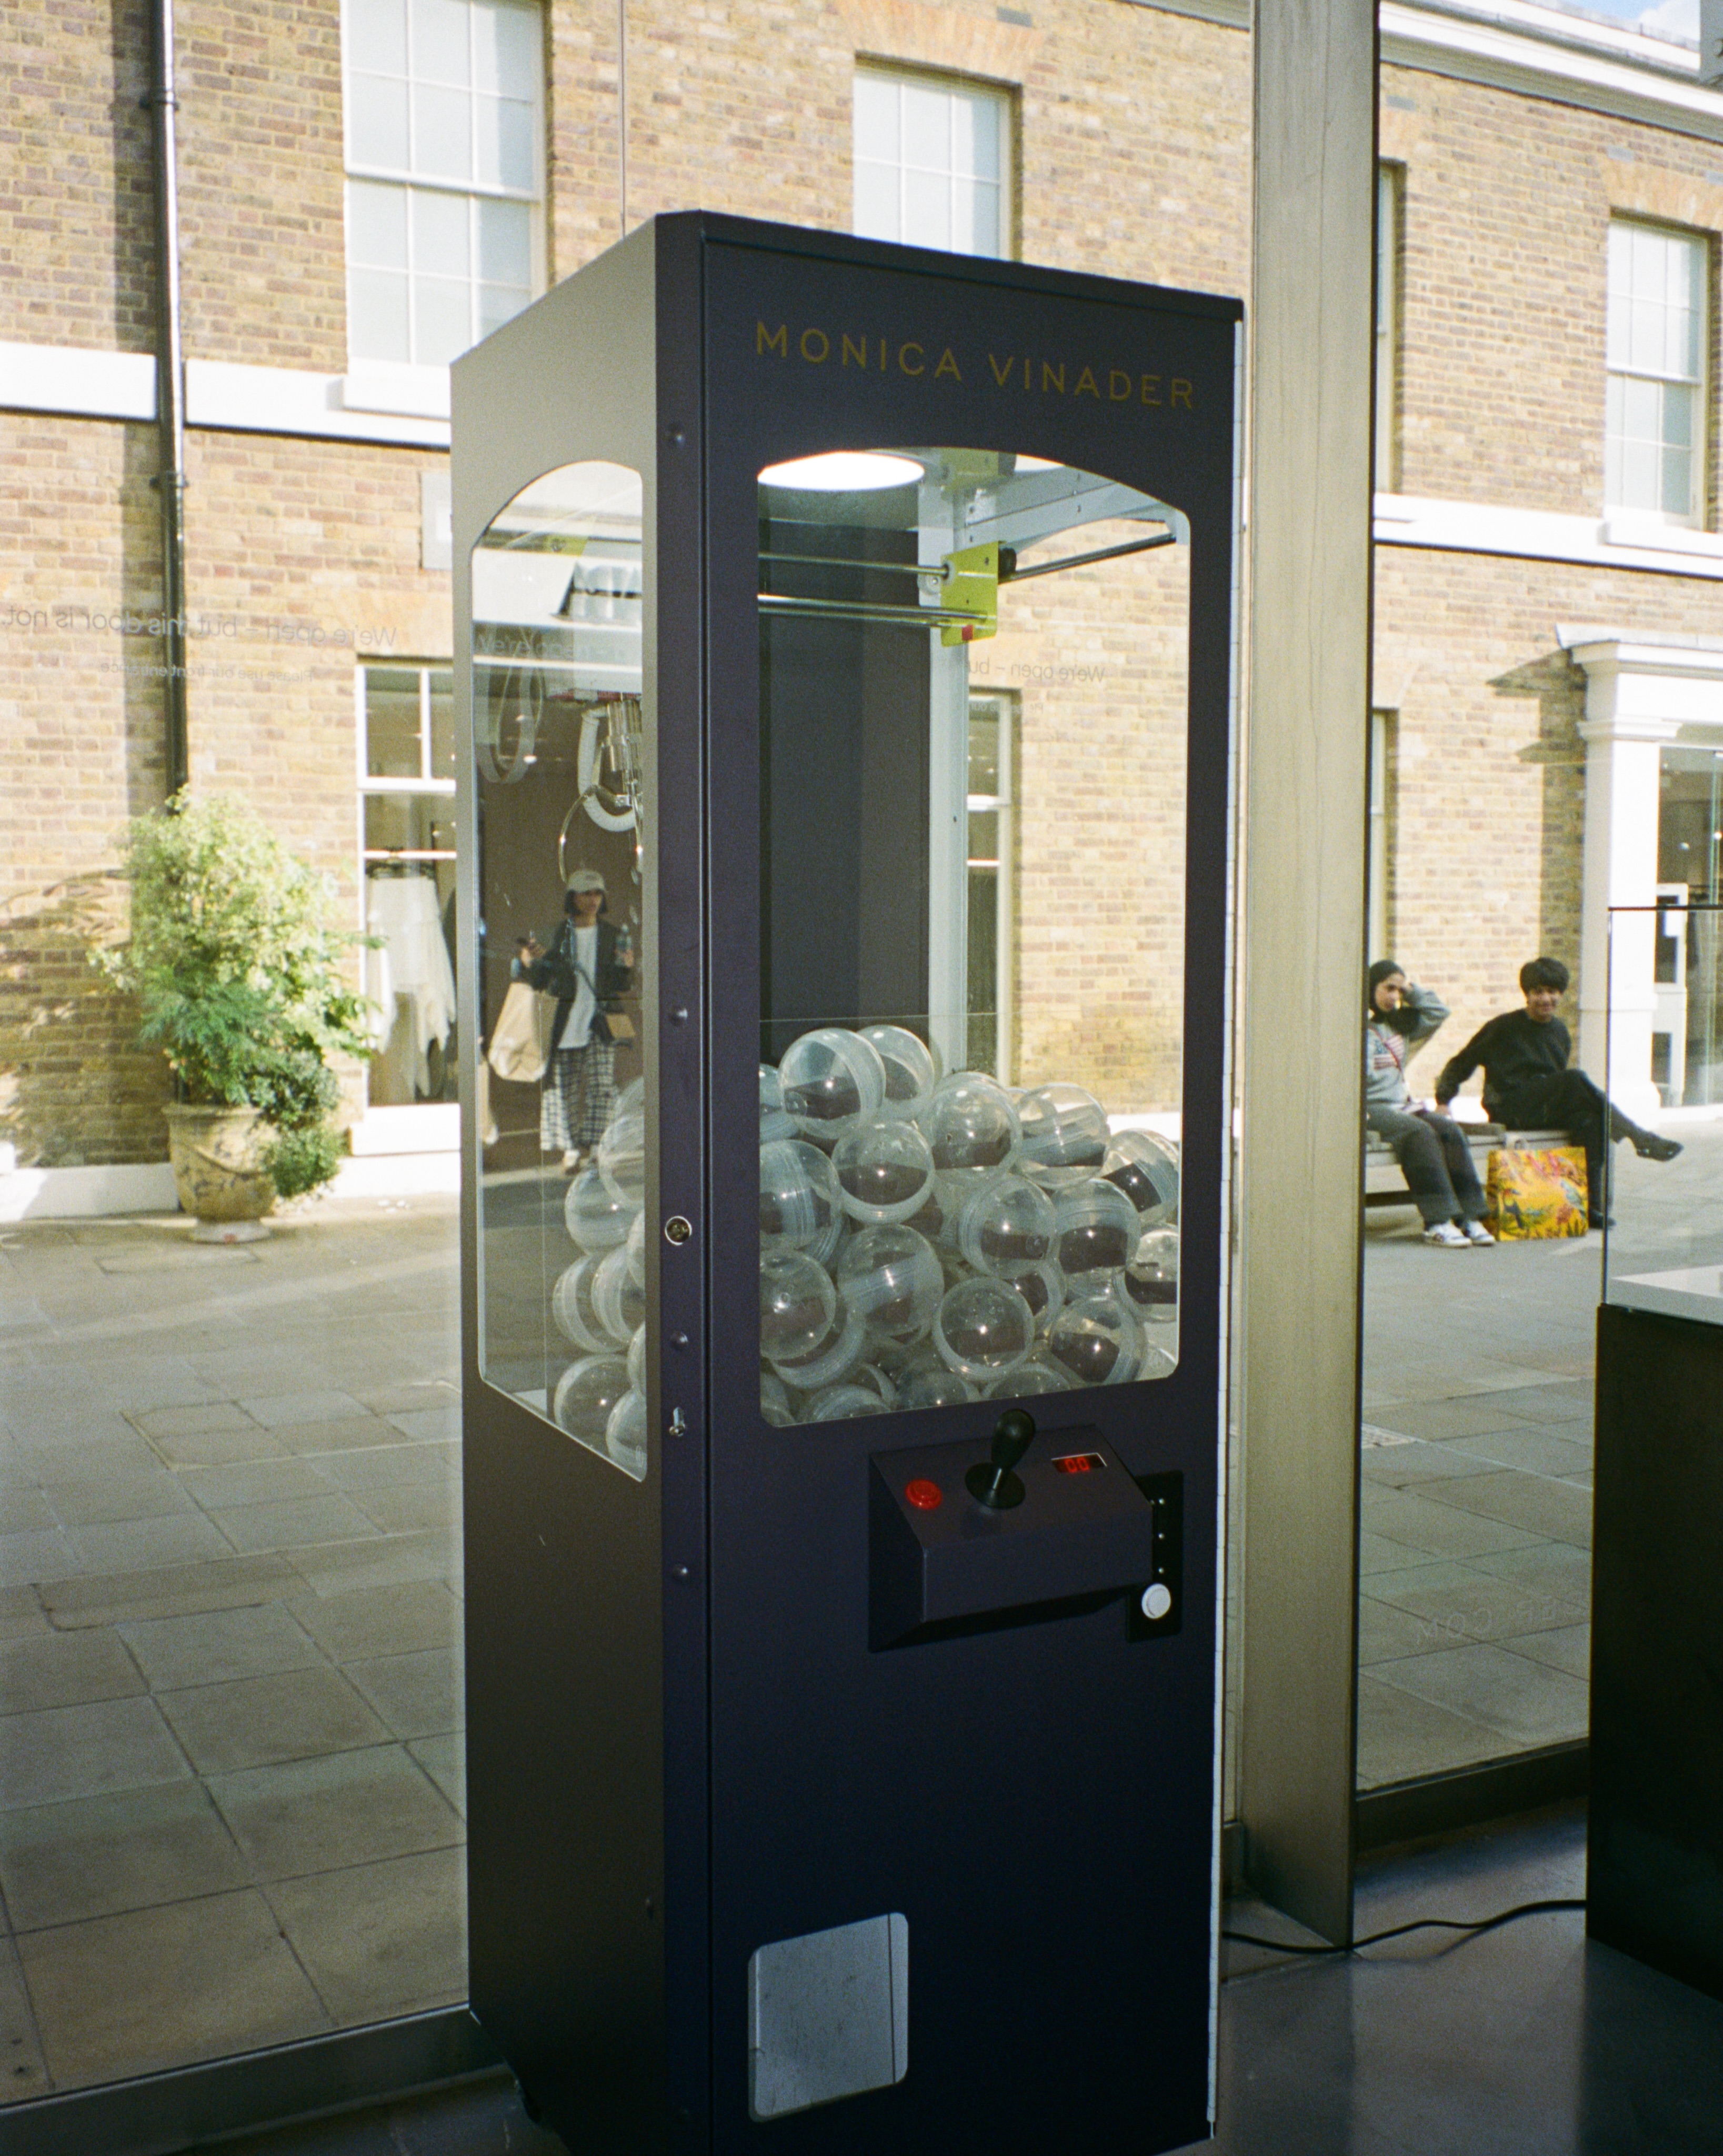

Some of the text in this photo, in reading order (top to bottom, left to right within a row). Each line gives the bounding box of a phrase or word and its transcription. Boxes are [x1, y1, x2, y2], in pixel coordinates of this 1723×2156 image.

[757, 321, 1194, 409] MONICA VINADER
[1064, 1456, 1090, 1473] 00
